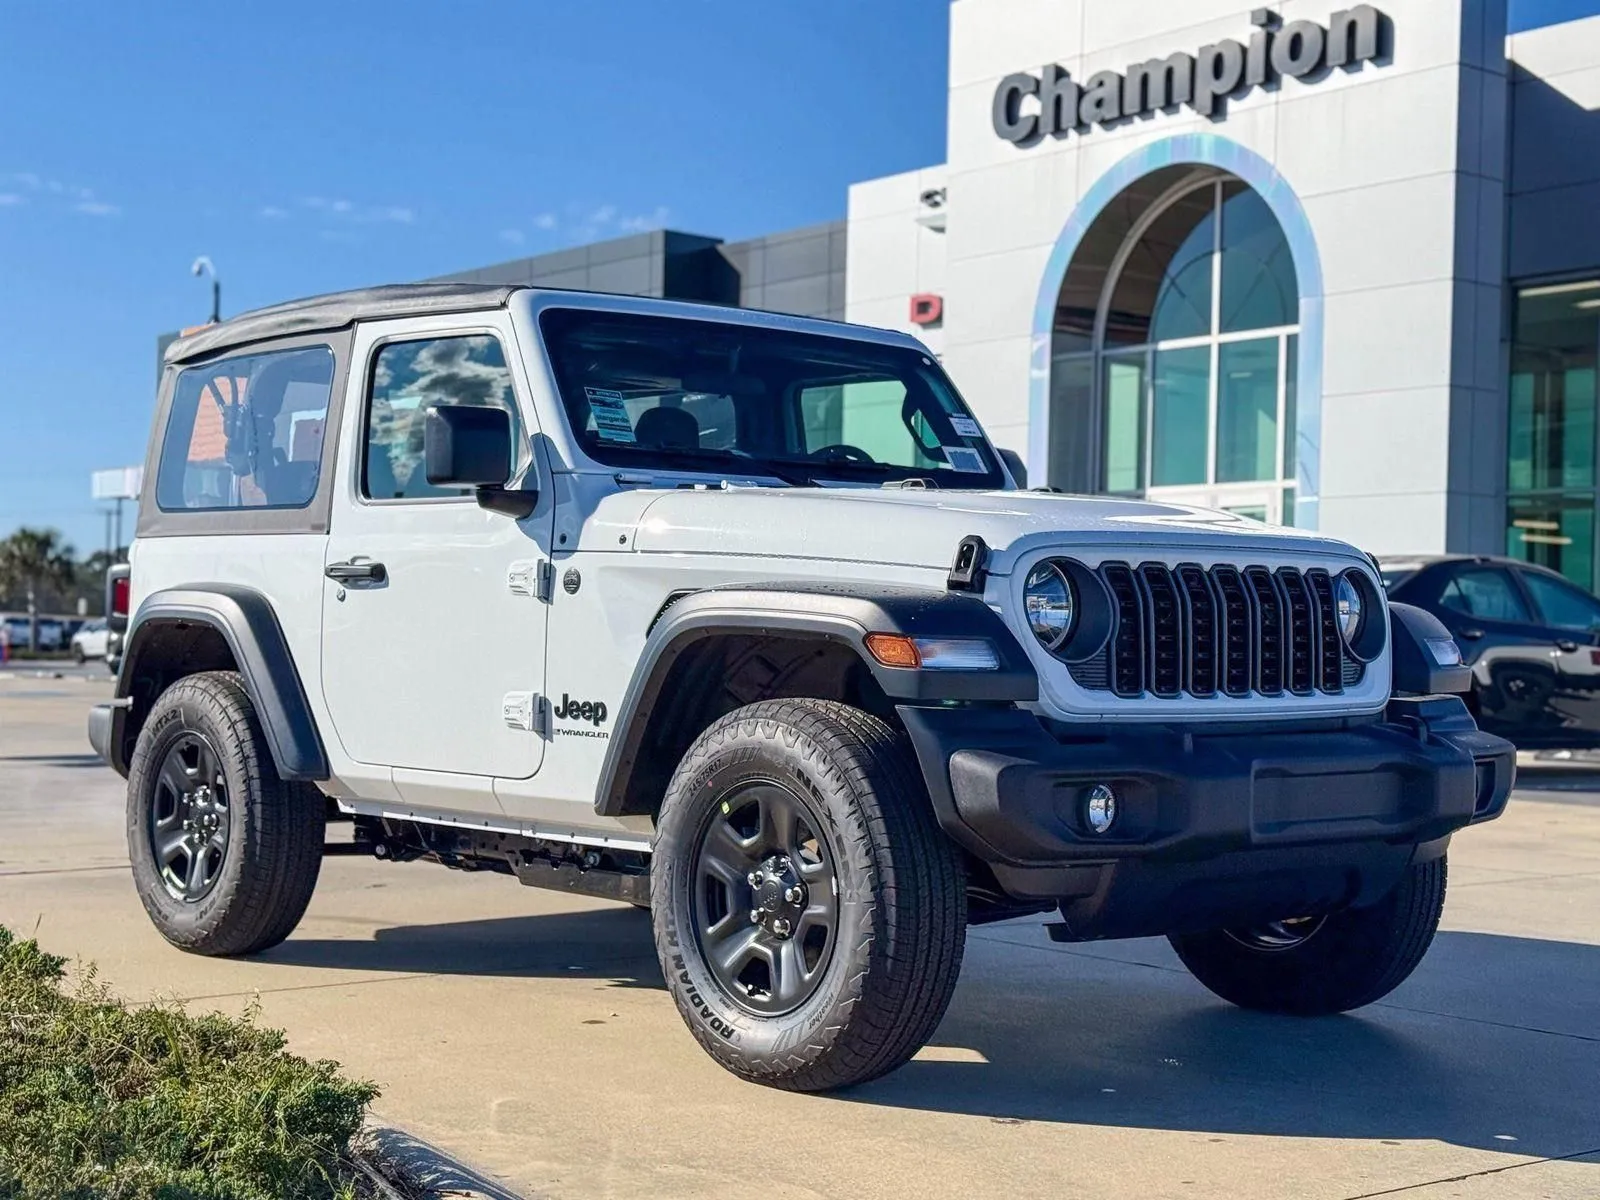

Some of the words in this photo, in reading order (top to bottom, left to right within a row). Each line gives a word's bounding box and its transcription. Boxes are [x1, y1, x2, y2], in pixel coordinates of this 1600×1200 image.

[992, 4, 1380, 143] Champion
[554, 693, 608, 727] Jeep
[561, 728, 609, 739] WRANGLER
[671, 953, 735, 1040] ROADIAN
